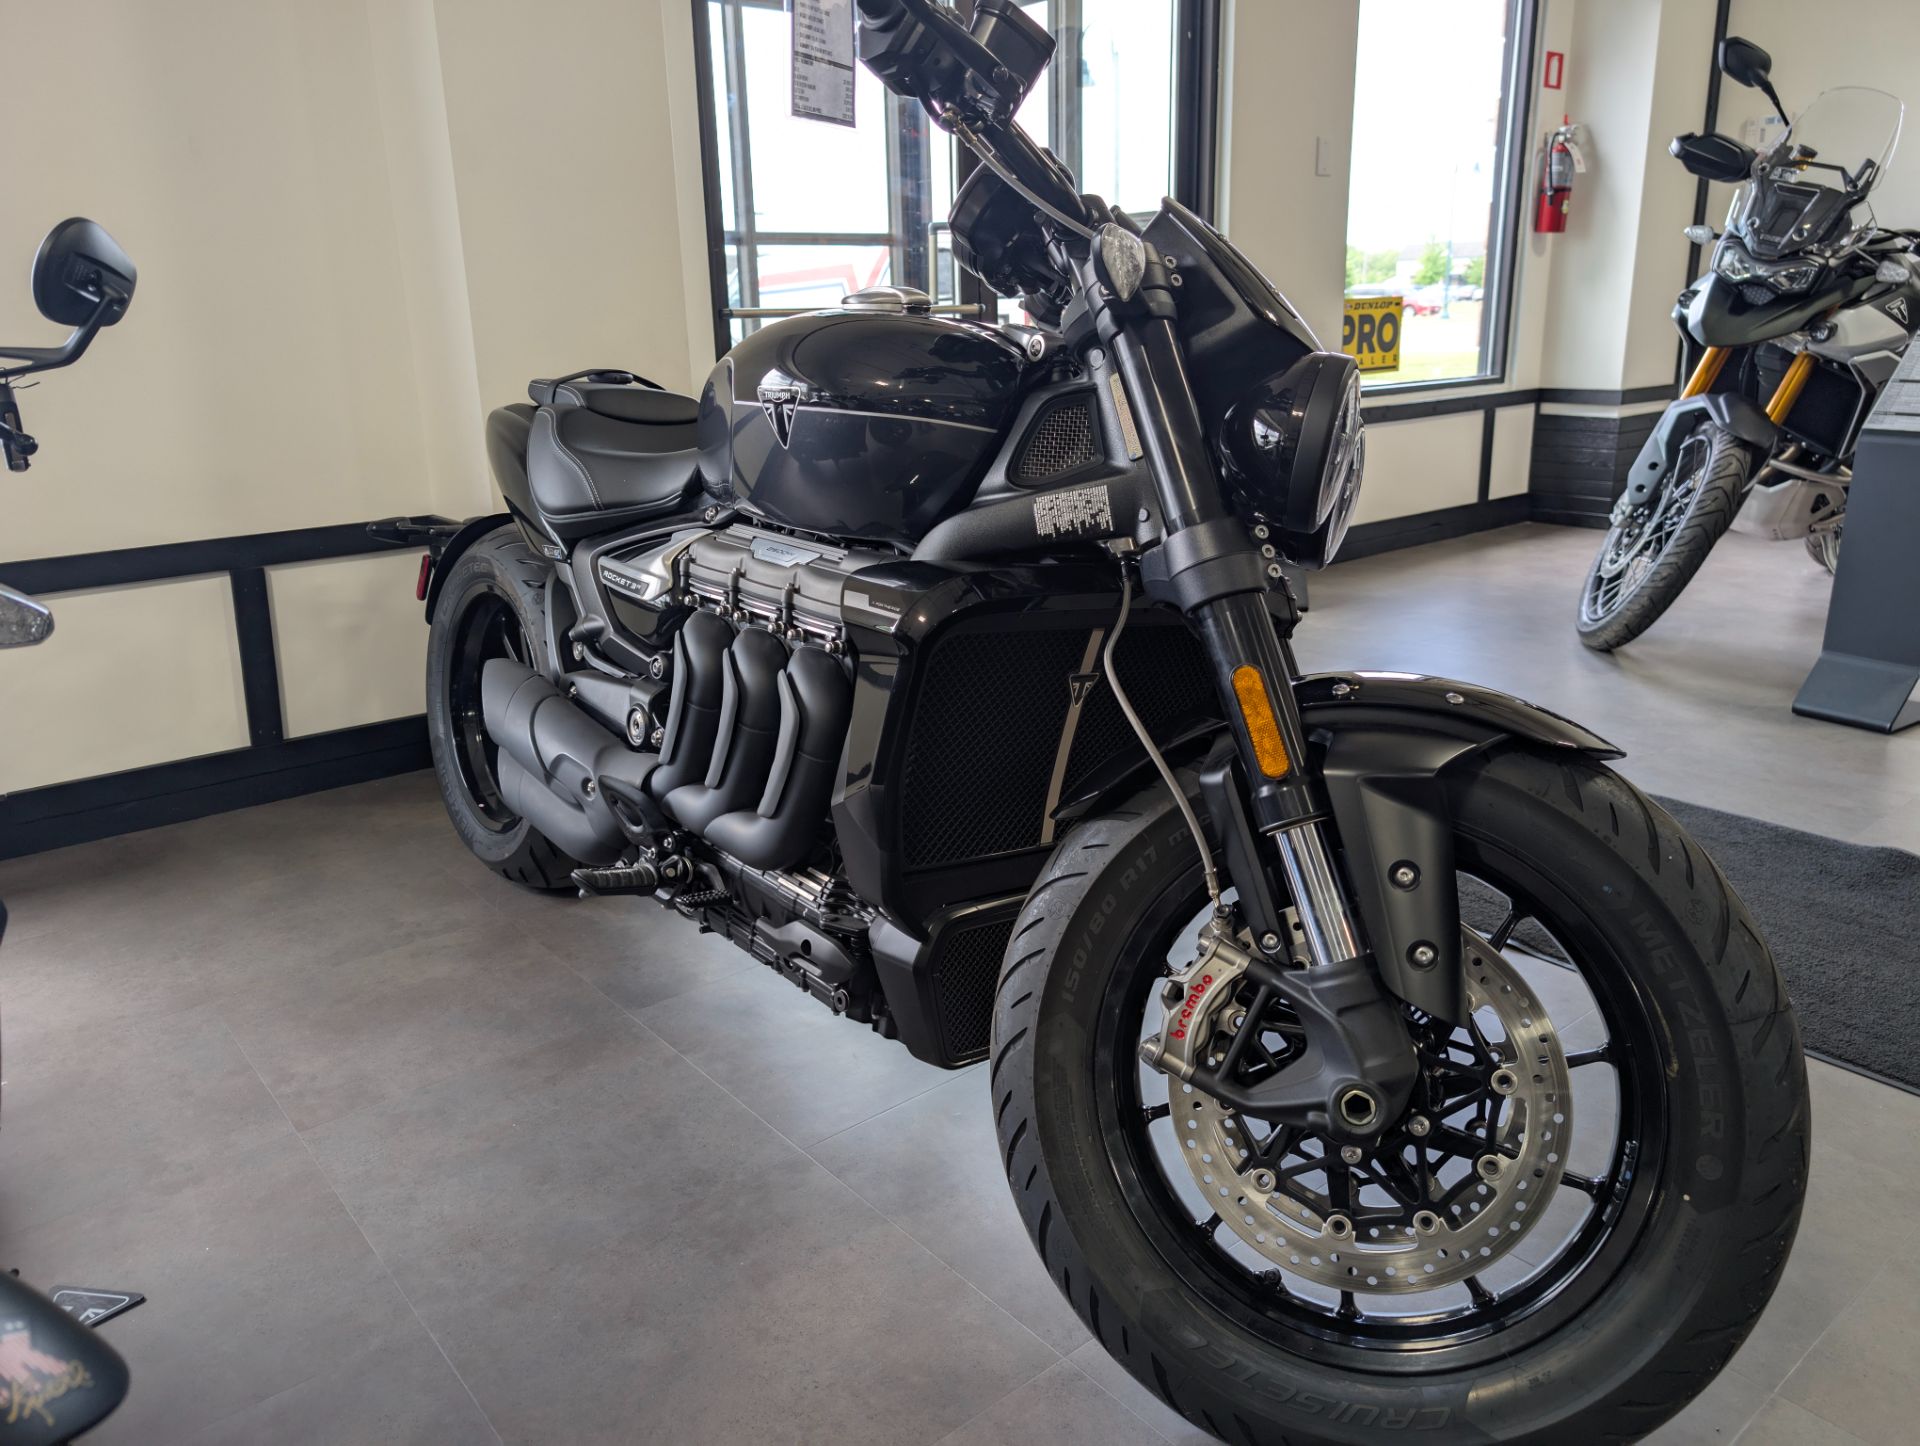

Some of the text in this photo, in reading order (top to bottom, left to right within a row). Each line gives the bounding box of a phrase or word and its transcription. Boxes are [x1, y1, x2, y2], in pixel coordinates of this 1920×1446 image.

[1343, 312, 1398, 354] PRO
[764, 391, 791, 400] TRIUMPH
[603, 570, 631, 587] ROCKET
[1061, 893, 1117, 1003] 150/80
[1120, 843, 1160, 891] R17
[1170, 974, 1213, 1040] brembo
[1630, 911, 1724, 1139] METZELER
